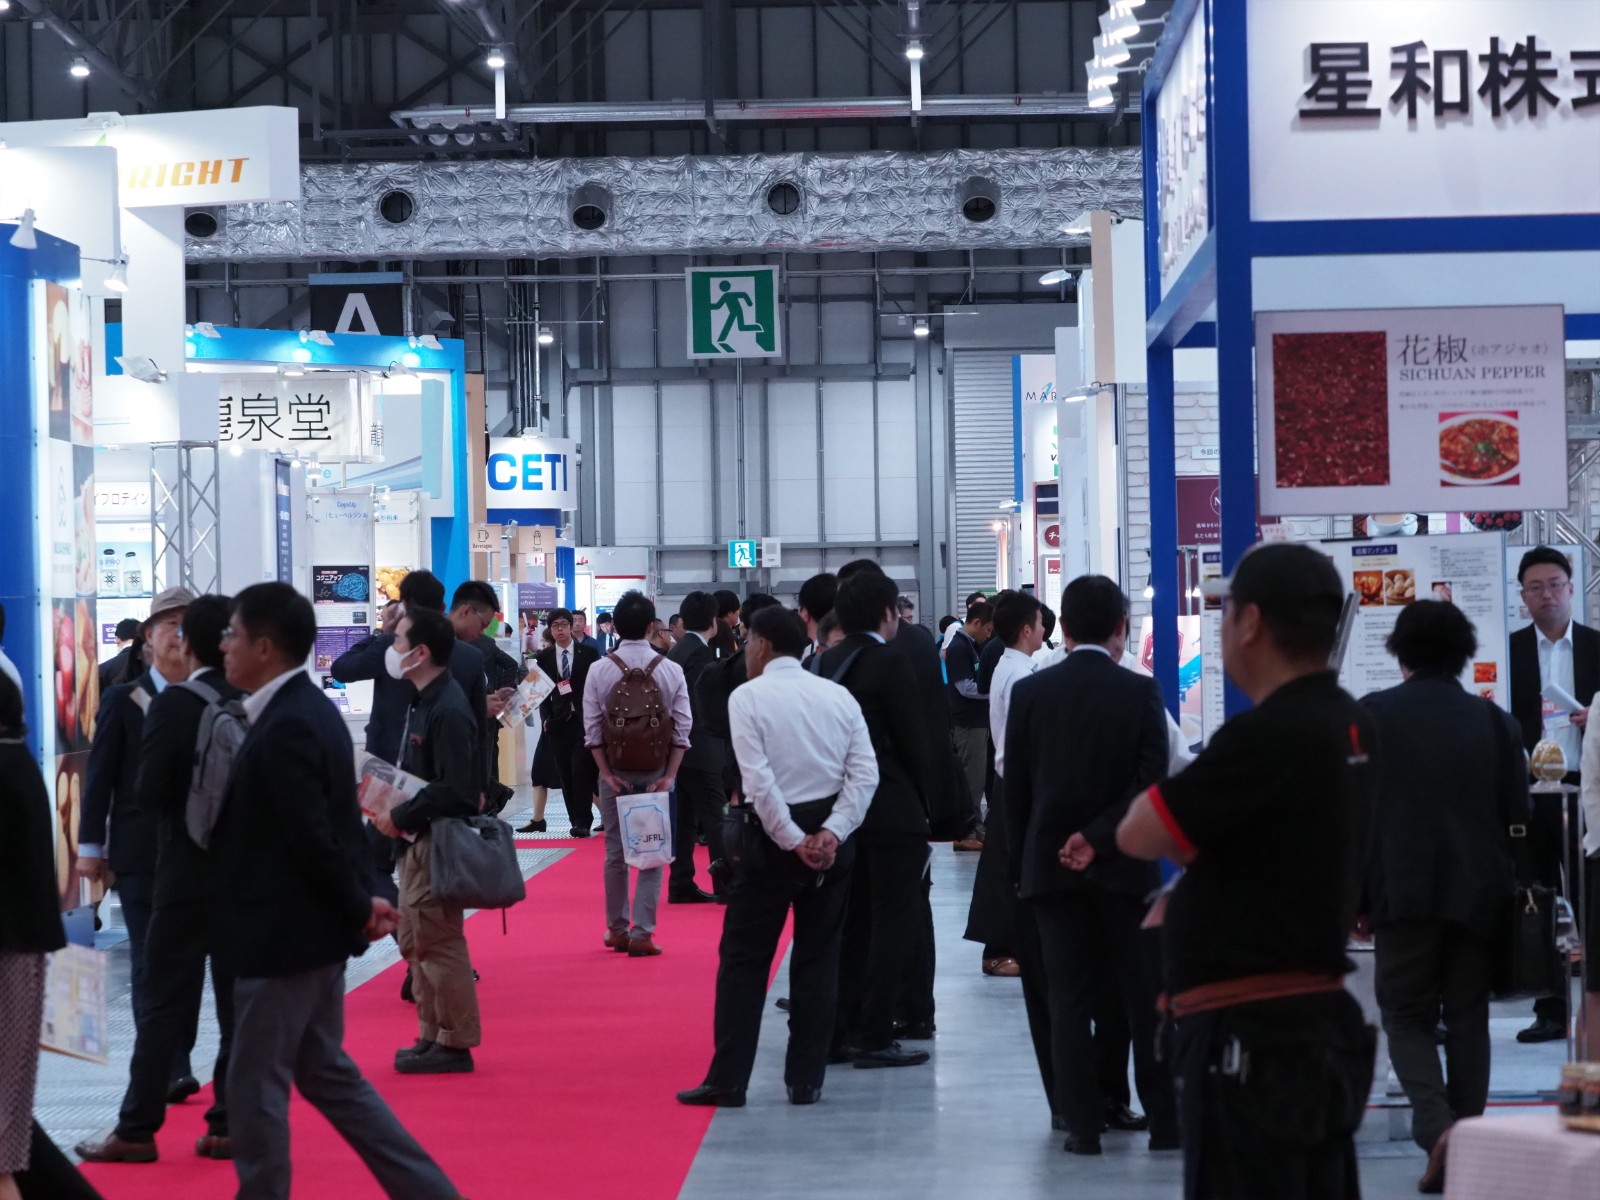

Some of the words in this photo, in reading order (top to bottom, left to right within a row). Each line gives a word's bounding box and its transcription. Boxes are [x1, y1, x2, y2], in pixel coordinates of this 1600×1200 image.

[335, 292, 381, 335] A
[1395, 333, 1468, 366] 花椒
[1400, 367, 1475, 381] SICHUAN
[1482, 365, 1545, 379] PEPPER
[643, 834, 664, 843] JFRL
